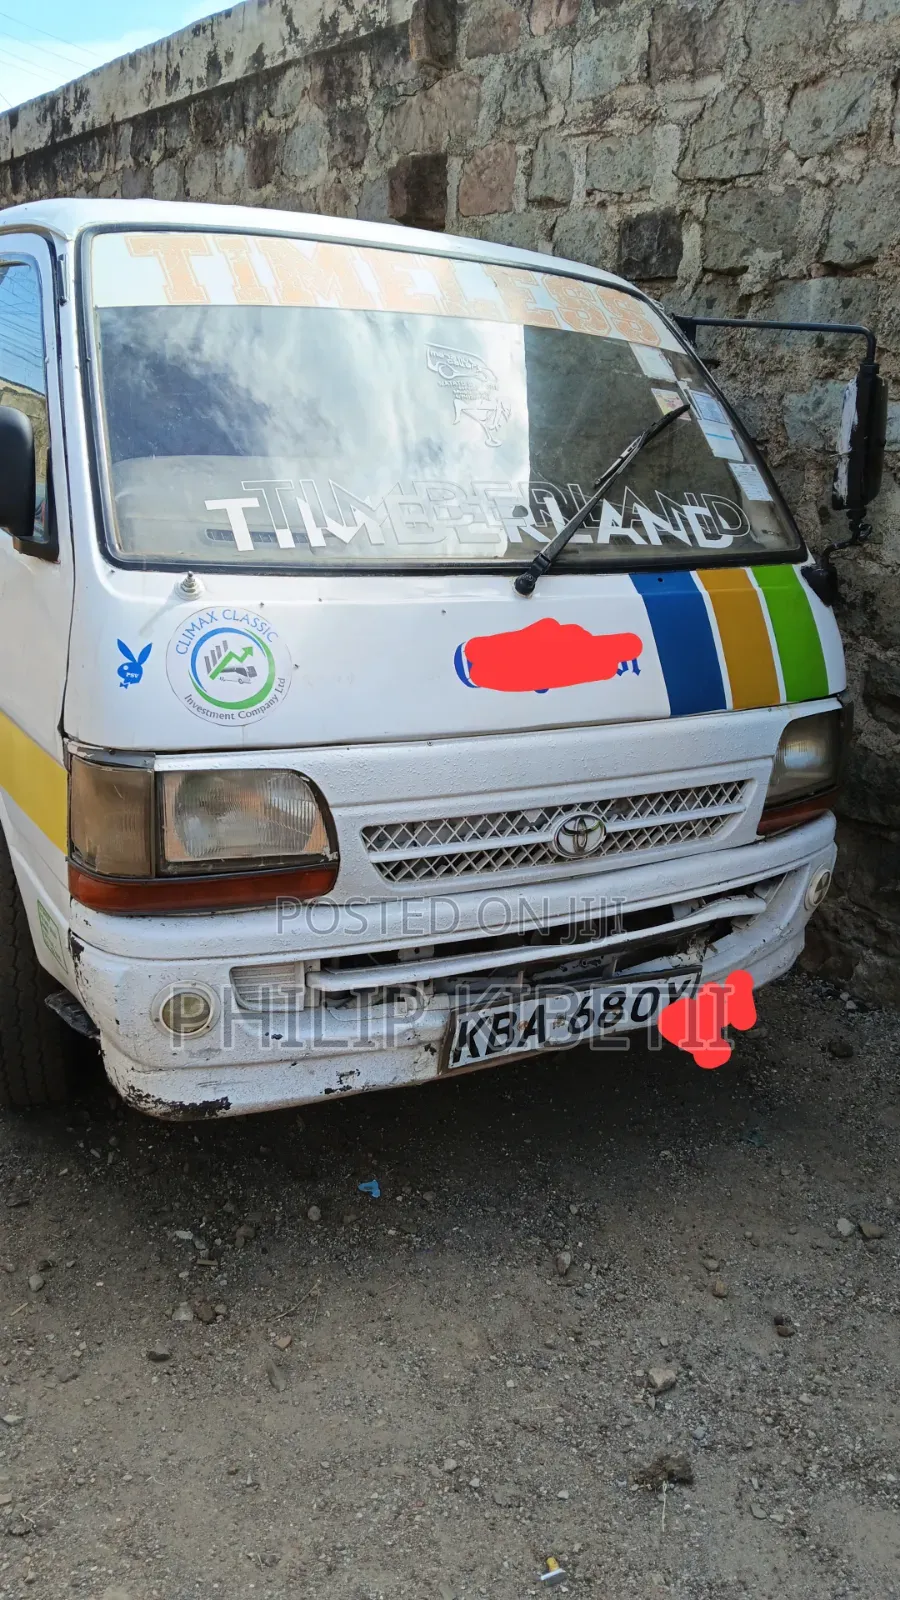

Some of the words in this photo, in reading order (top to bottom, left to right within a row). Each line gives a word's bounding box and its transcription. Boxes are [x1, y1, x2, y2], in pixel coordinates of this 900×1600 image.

[124, 235, 662, 347] TIMELESS
[175, 611, 218, 655] CLIMAX
[222, 609, 279, 643] CLASSIC
[184, 694, 235, 720] Investment
[238, 694, 279, 719] Company
[275, 677, 286, 694] Ltd
[452, 1004, 546, 1064] KBA
